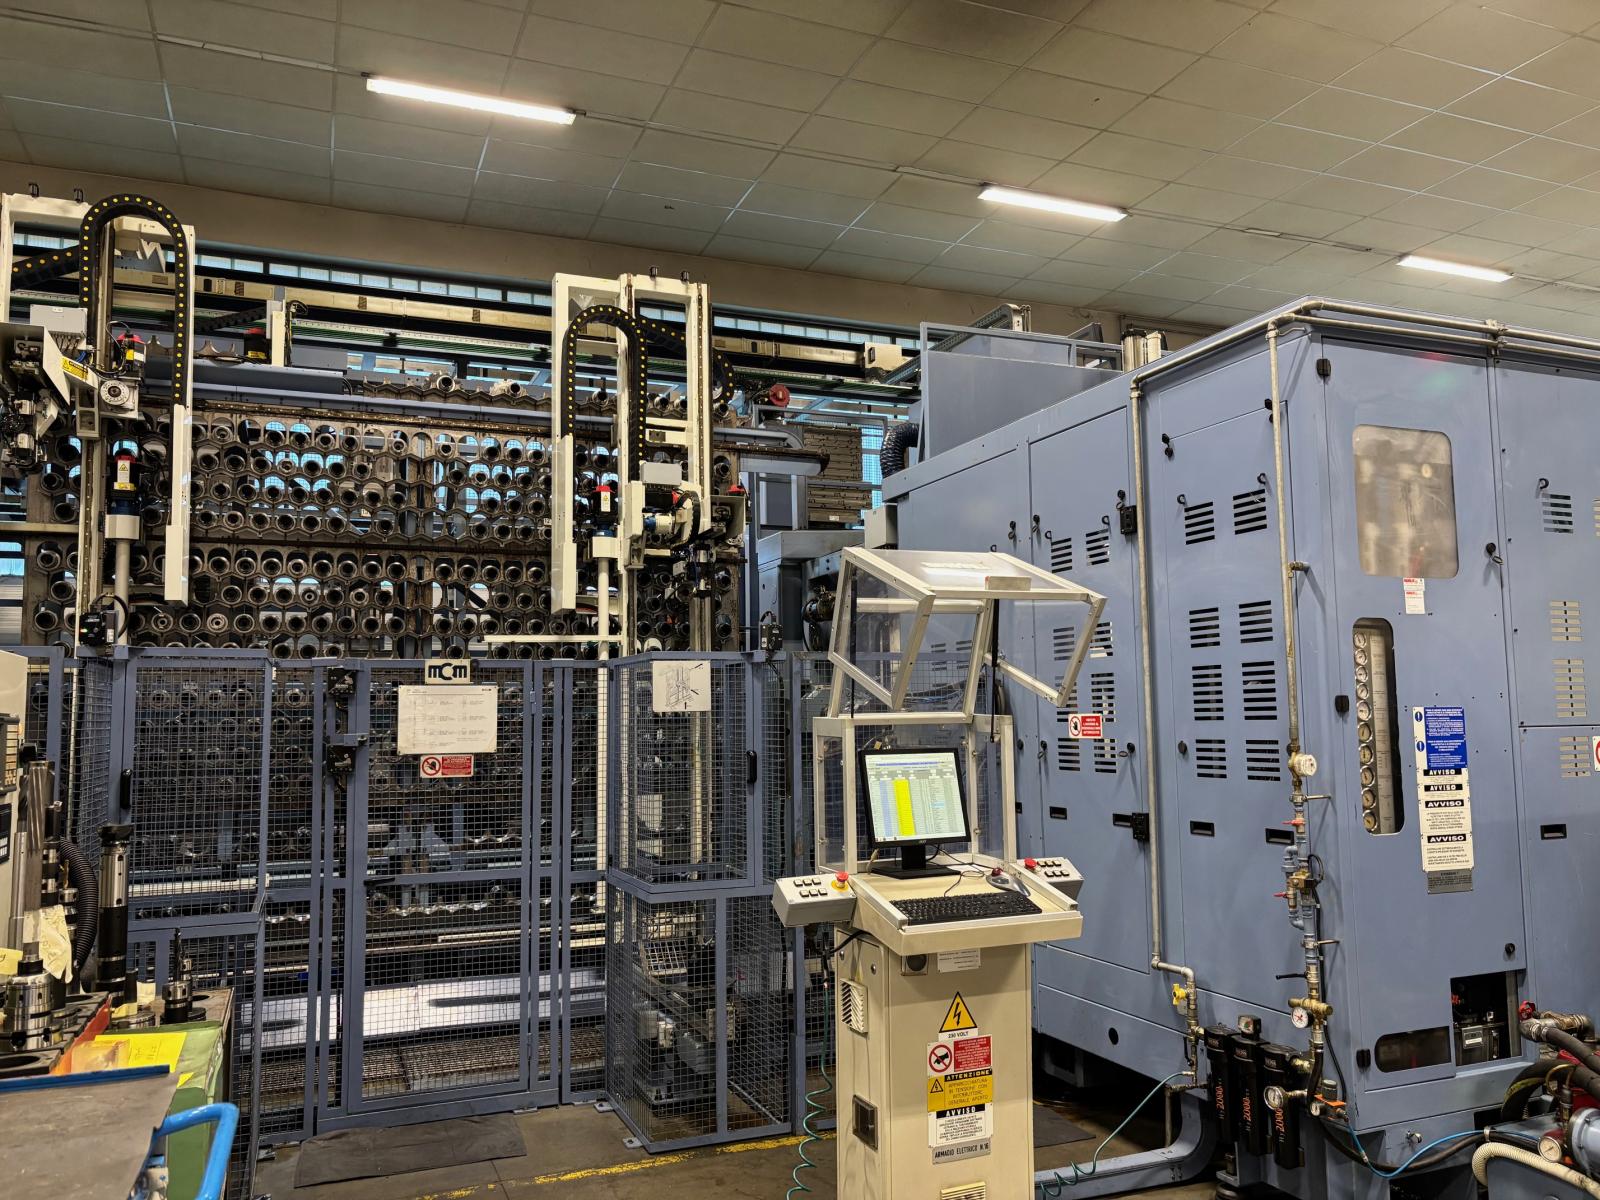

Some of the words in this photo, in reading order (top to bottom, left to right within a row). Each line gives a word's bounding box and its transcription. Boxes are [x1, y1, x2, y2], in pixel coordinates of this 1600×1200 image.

[1427, 800, 1462, 808] AVVISO
[1430, 835, 1464, 843] AVVISO
[945, 1106, 976, 1117] AVVISO
[934, 1149, 955, 1158] ARMADIO
[956, 1145, 978, 1155] ELETTRICO
